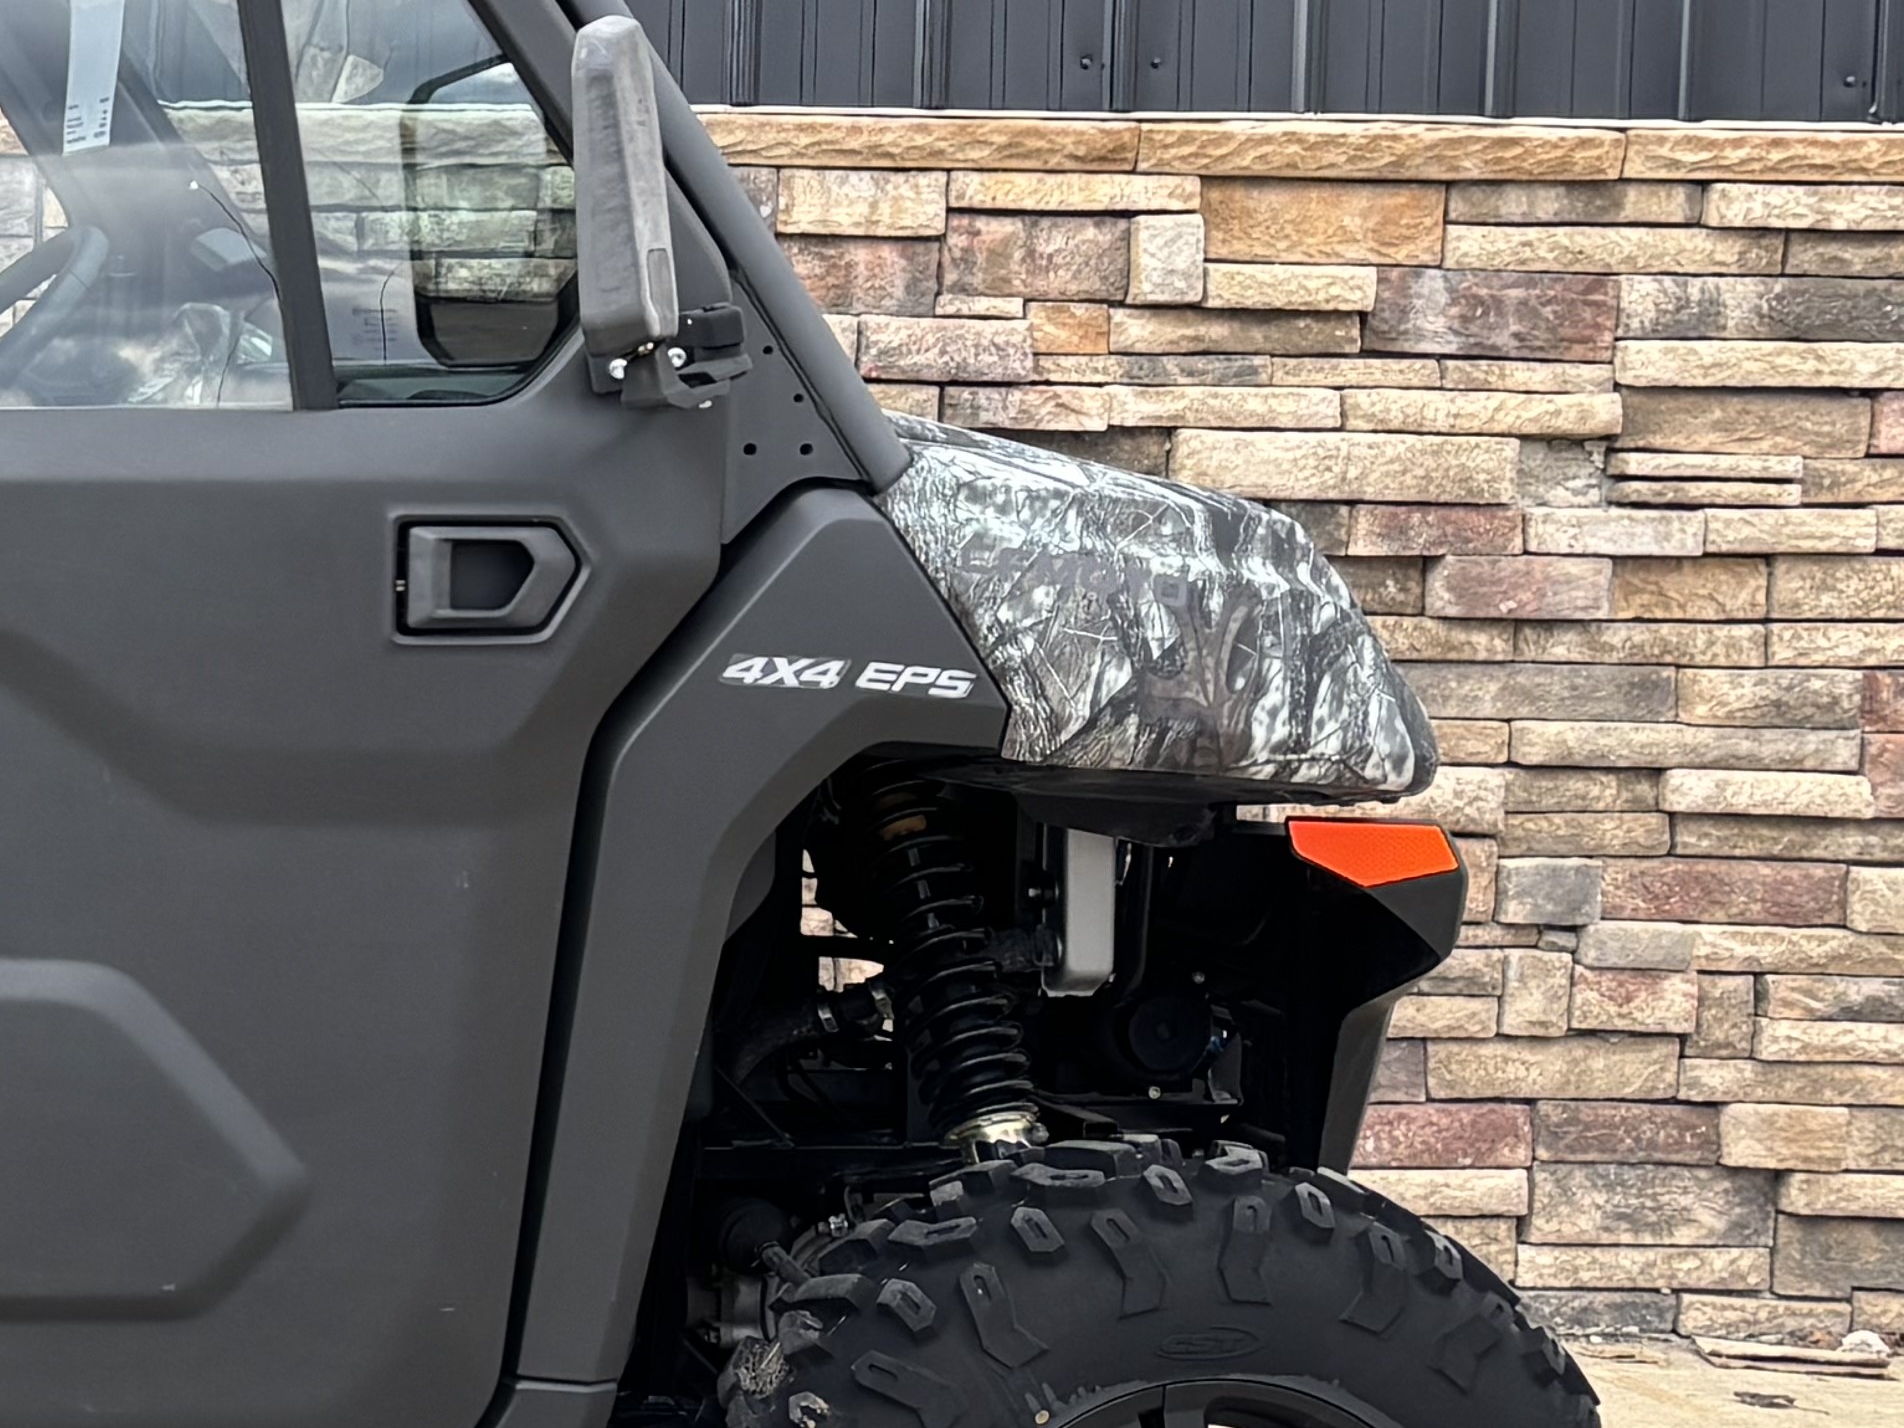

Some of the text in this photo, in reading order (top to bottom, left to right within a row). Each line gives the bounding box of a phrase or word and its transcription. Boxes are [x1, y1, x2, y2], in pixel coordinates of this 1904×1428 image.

[721, 656, 977, 699] 4X4 EPS
[1160, 1332, 1245, 1354] CST
